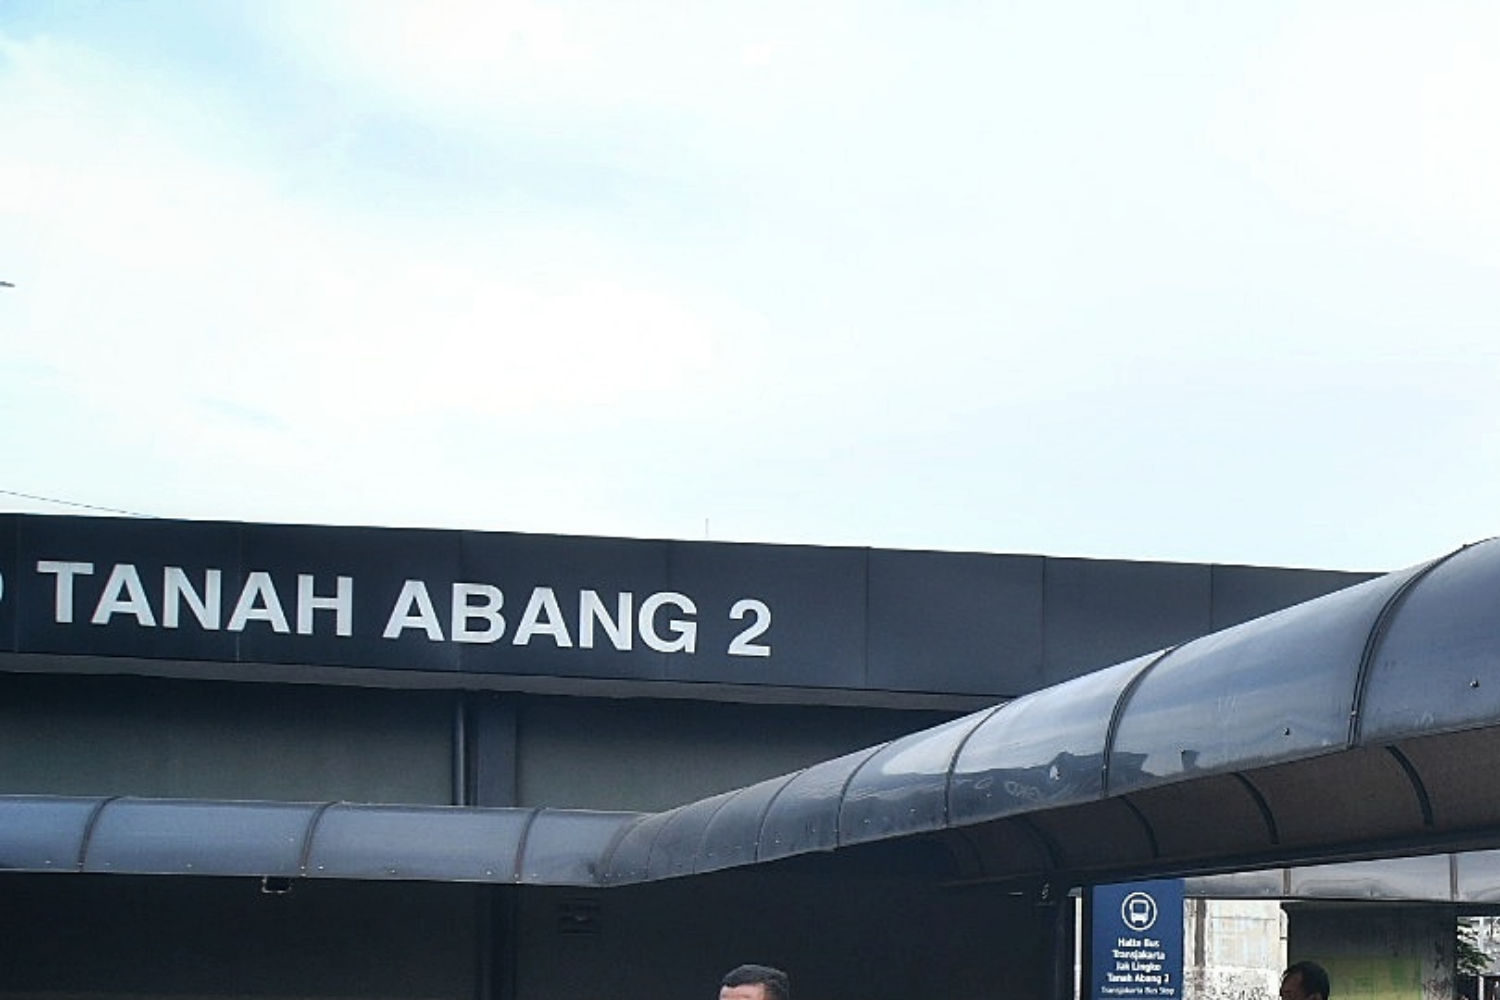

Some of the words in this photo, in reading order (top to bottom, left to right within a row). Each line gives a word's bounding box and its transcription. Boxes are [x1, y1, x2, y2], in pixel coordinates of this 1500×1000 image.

[36, 560, 353, 637] TANAH
[382, 579, 698, 654] ABANG
[727, 598, 772, 657] 2
[1144, 938, 1160, 948] Bus
